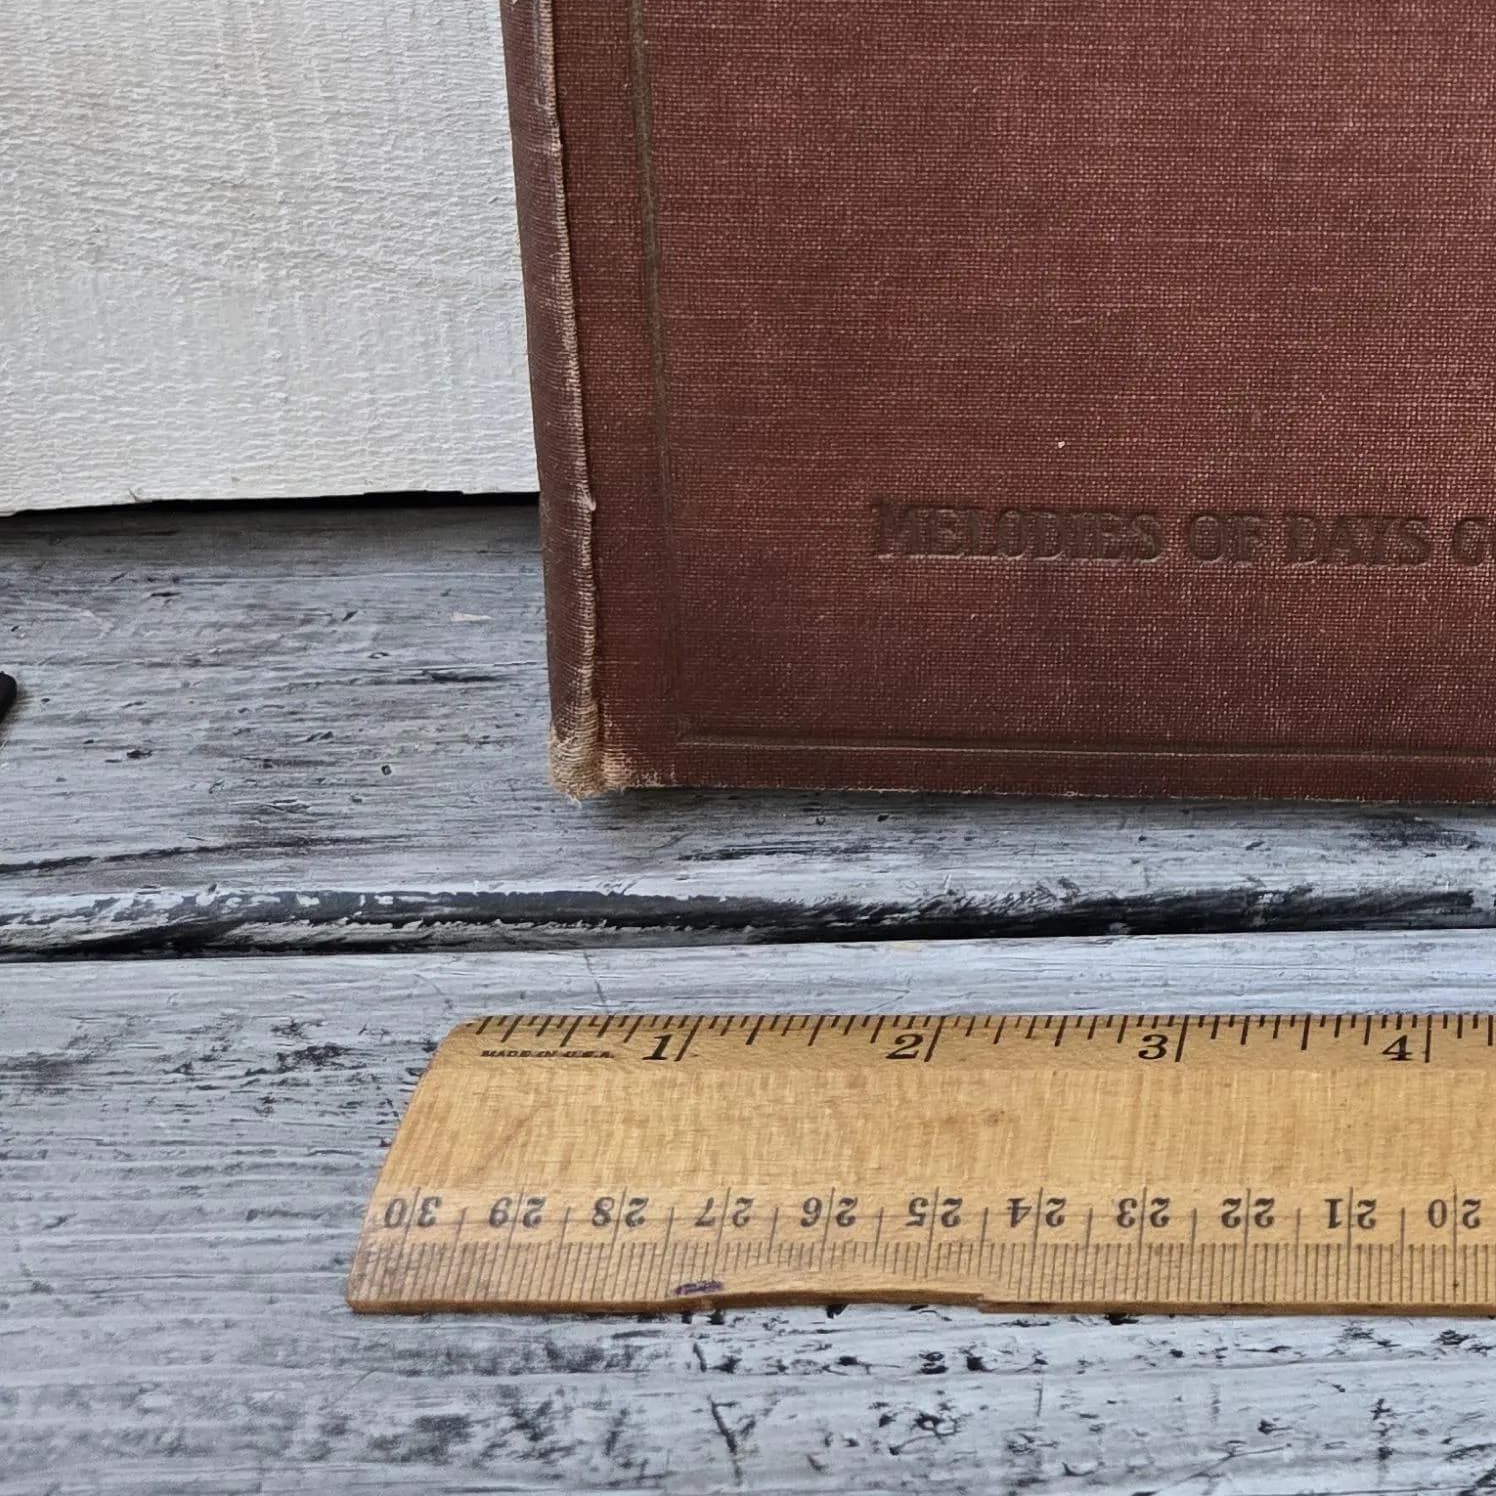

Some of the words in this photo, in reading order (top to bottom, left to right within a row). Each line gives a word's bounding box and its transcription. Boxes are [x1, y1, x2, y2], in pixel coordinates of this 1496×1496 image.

[870, 499, 1164, 560] MELODIES
[1188, 510, 1260, 566] OF
[1285, 513, 1430, 568] DAYS
[643, 1034, 672, 1061] 1
[886, 1034, 923, 1060] 2
[1138, 1034, 1168, 1060] 3
[1382, 1035, 1412, 1061] 4
[384, 1197, 441, 1229] 30
[487, 1197, 545, 1229] 29
[592, 1197, 648, 1229] 28
[694, 1197, 753, 1229] 27
[800, 1197, 858, 1229] 26
[905, 1197, 963, 1229] 25
[1006, 1197, 1066, 1229] 24
[1115, 1197, 1170, 1229] 23
[1220, 1197, 1276, 1229] 22
[1324, 1197, 1377, 1229] 21
[1427, 1197, 1482, 1229] 20
